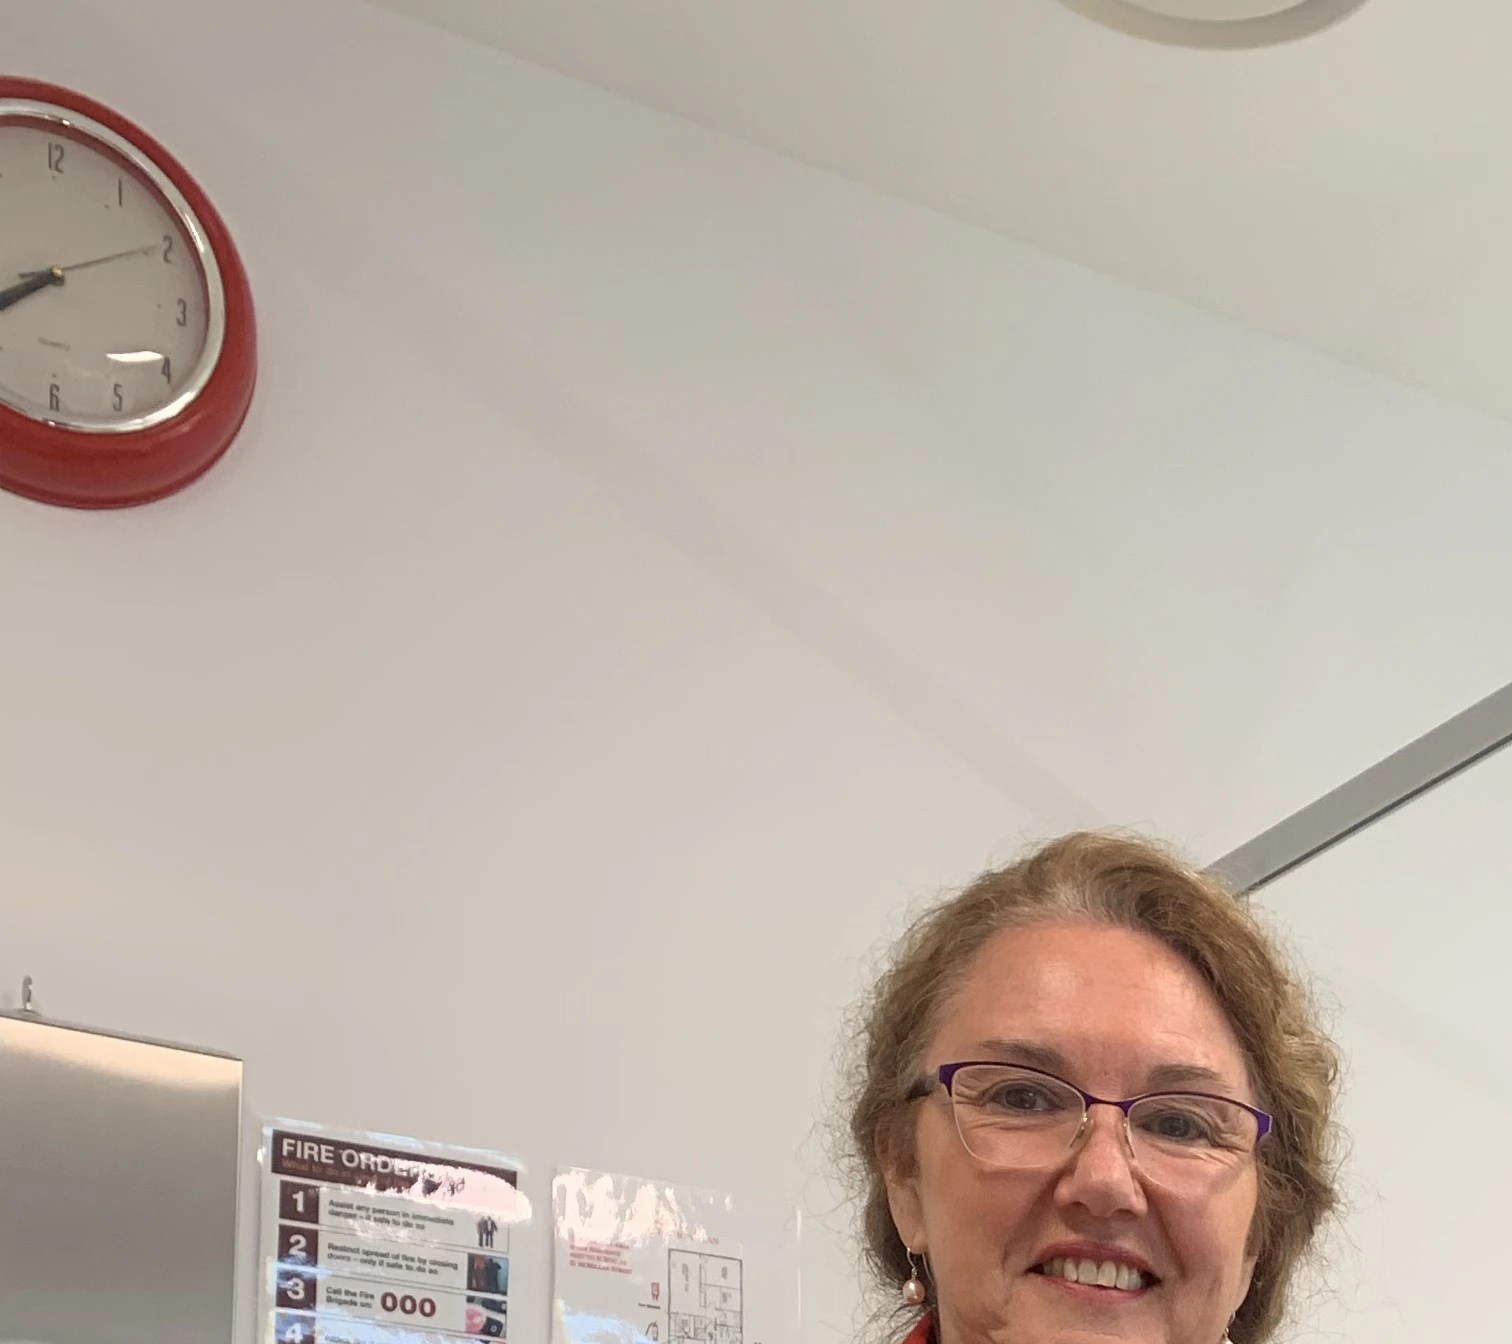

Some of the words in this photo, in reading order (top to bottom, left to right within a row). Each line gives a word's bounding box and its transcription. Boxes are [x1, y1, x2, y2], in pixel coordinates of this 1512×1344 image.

[48, 143, 65, 173] 12
[117, 178, 124, 207] 1
[162, 235, 173, 264] 2
[177, 298, 188, 327] 3
[161, 356, 172, 385] 4
[49, 384, 60, 412] 6
[112, 384, 123, 412] 5
[282, 1137, 335, 1164] FIRE
[292, 1190, 305, 1213] 1
[289, 1234, 307, 1258] 2
[287, 1277, 305, 1300] 3
[380, 1292, 436, 1318] 000
[285, 1322, 303, 1344] 4
